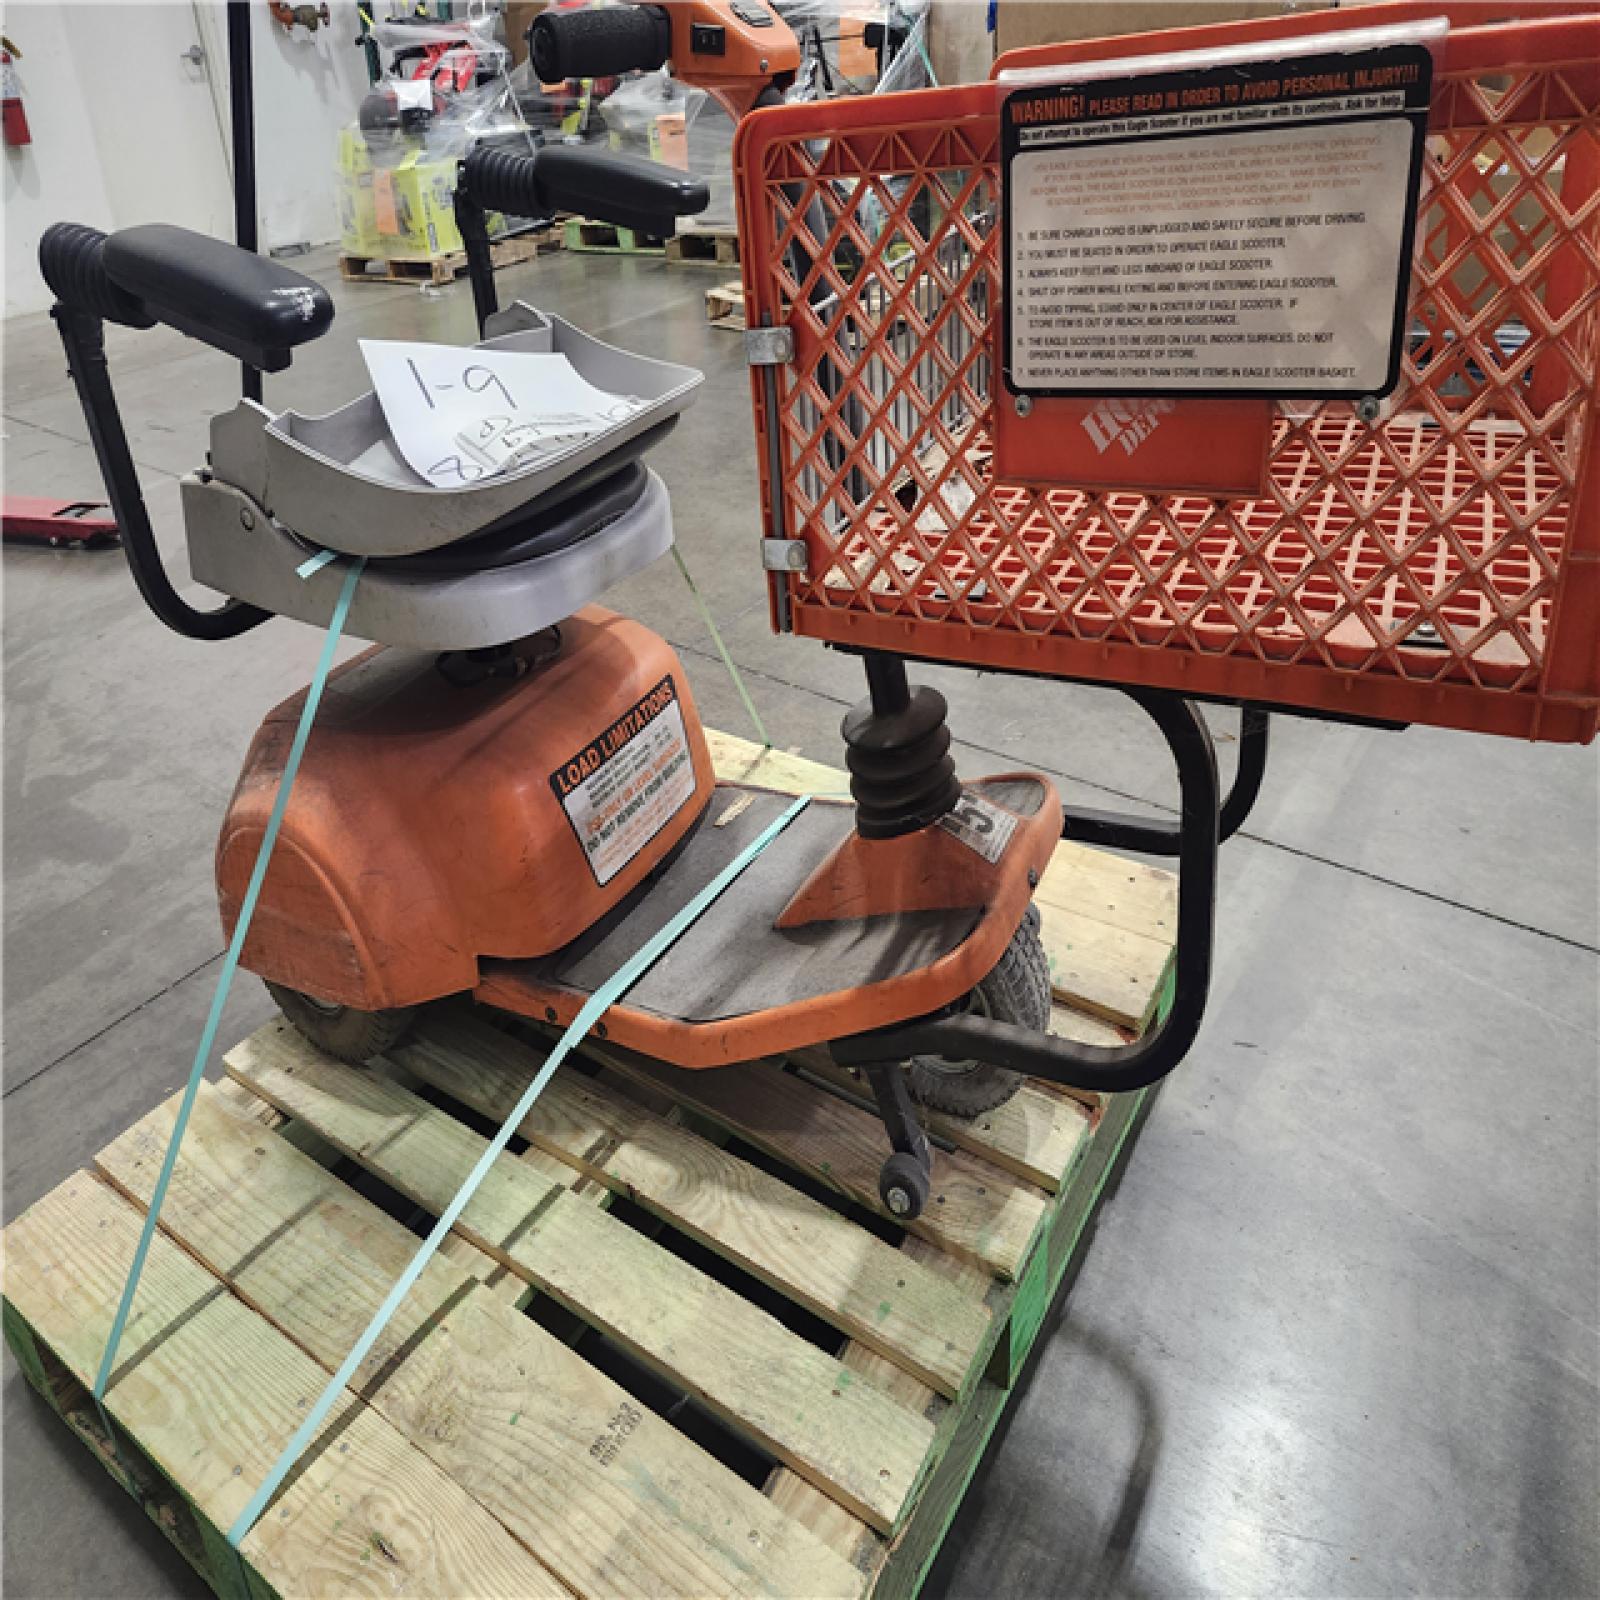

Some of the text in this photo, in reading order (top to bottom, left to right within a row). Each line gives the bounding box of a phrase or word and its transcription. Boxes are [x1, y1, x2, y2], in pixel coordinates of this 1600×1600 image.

[1011, 95, 1085, 124] WARNING!
[1090, 97, 1130, 115] PLEASE
[1132, 92, 1163, 110] READ
[1166, 92, 1178, 108] IN
[1182, 86, 1220, 106] ORDER
[1224, 84, 1239, 101] TO
[1242, 79, 1281, 99] AVOID
[1283, 71, 1350, 96] PERSONAL
[1082, 124, 1110, 137] operate
[1127, 120, 1148, 132] Eagle
[1189, 115, 1203, 127] you
[1271, 106, 1291, 116] with
[1346, 98, 1363, 109] Ask
[1365, 96, 1378, 107] for
[1062, 227, 1100, 238] CHARGER
[1102, 225, 1126, 236] CORD
[1284, 214, 1321, 228] BEFORE
[1156, 242, 1168, 253] TO
[1209, 239, 1238, 251] EAGLE
[1259, 277, 1288, 289] EAGLE
[1209, 299, 1236, 310] EAGLE
[1297, 333, 1311, 343] DO
[1314, 332, 1335, 343] NOT
[1272, 367, 1316, 377] SCOOTER
[407, 357, 518, 410] 1-9
[556, 746, 601, 793] LOAD
[600, 681, 673, 759] LIMITATIONS
